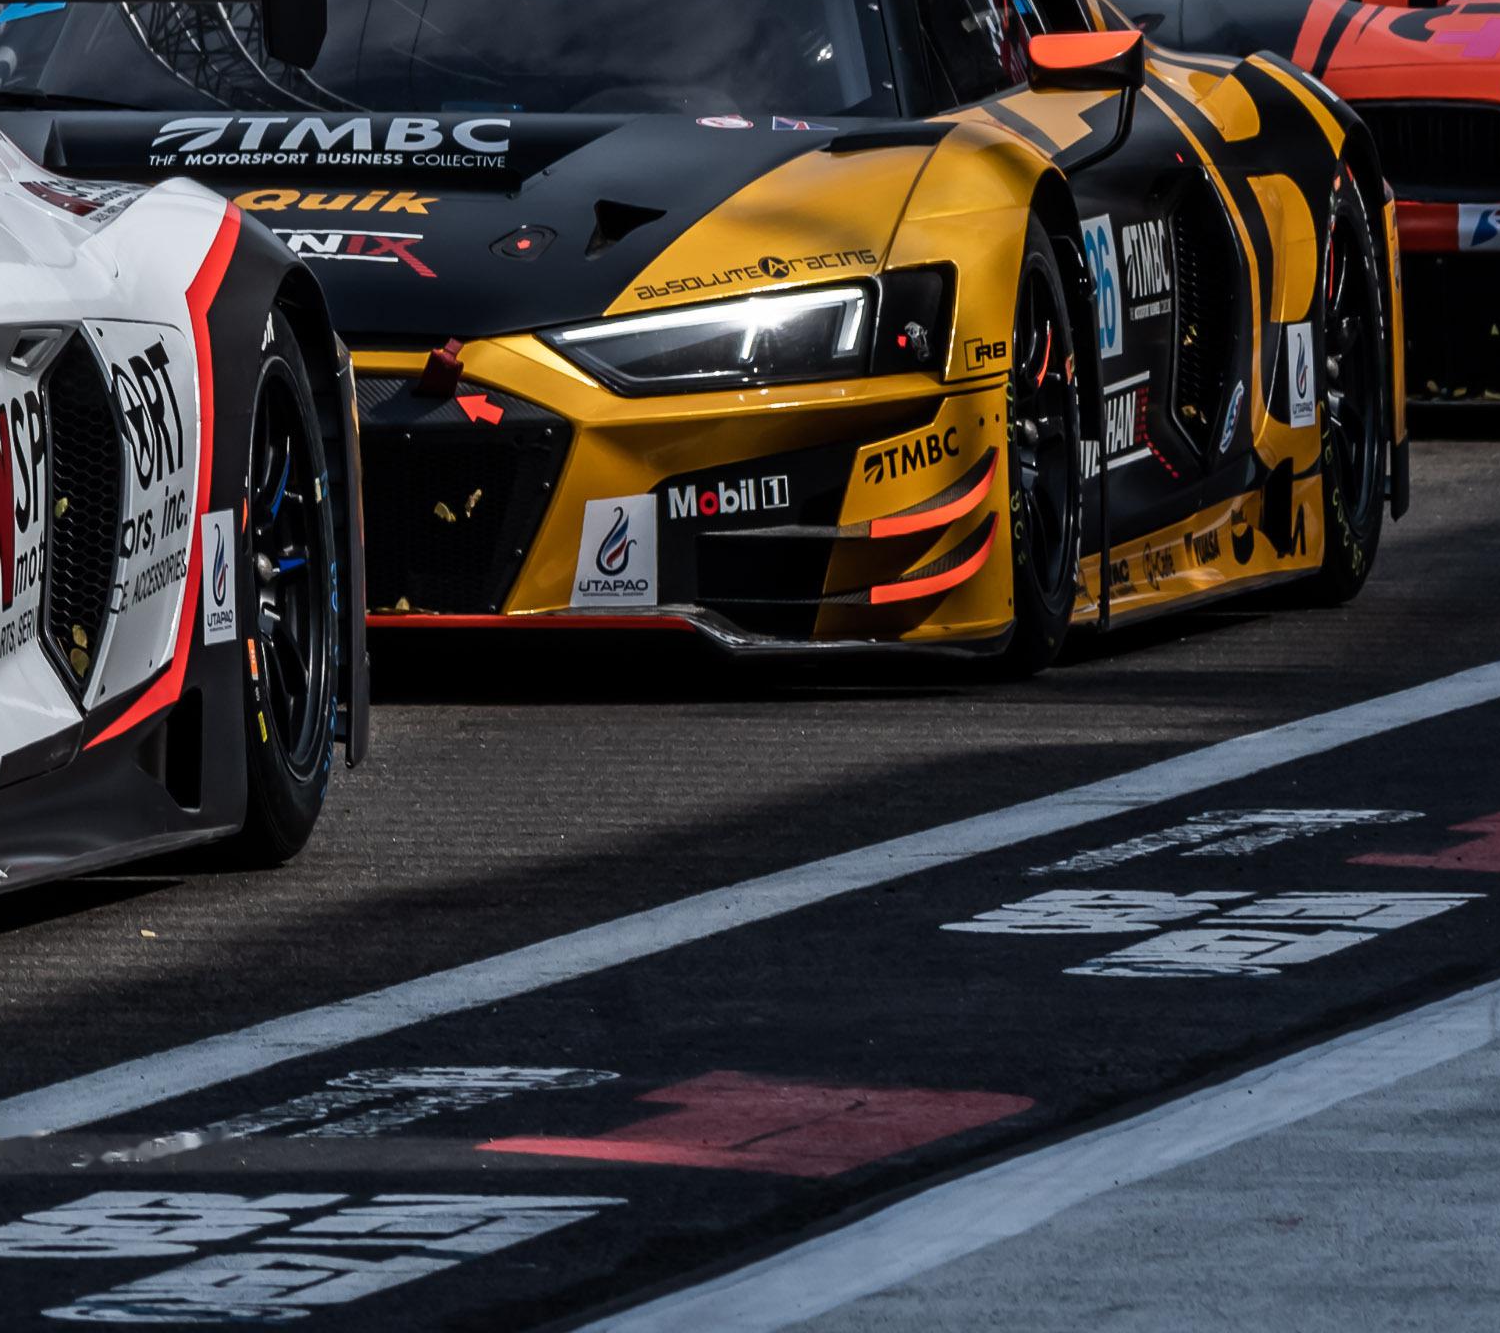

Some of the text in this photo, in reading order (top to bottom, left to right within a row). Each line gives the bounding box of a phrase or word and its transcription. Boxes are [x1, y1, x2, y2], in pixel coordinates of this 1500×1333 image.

[233, 116, 512, 153] TMBC
[184, 152, 309, 166] MOTORSPORT
[316, 152, 404, 165] BUSINESS
[411, 153, 506, 169] COLLECTIVE
[1127, 218, 1171, 300] TMBC
[975, 340, 1008, 361] R8
[882, 432, 961, 483] TMBC
[667, 478, 757, 520] Mobil
[578, 579, 649, 593] UTAPAO
[206, 610, 234, 627] UTAPAO
